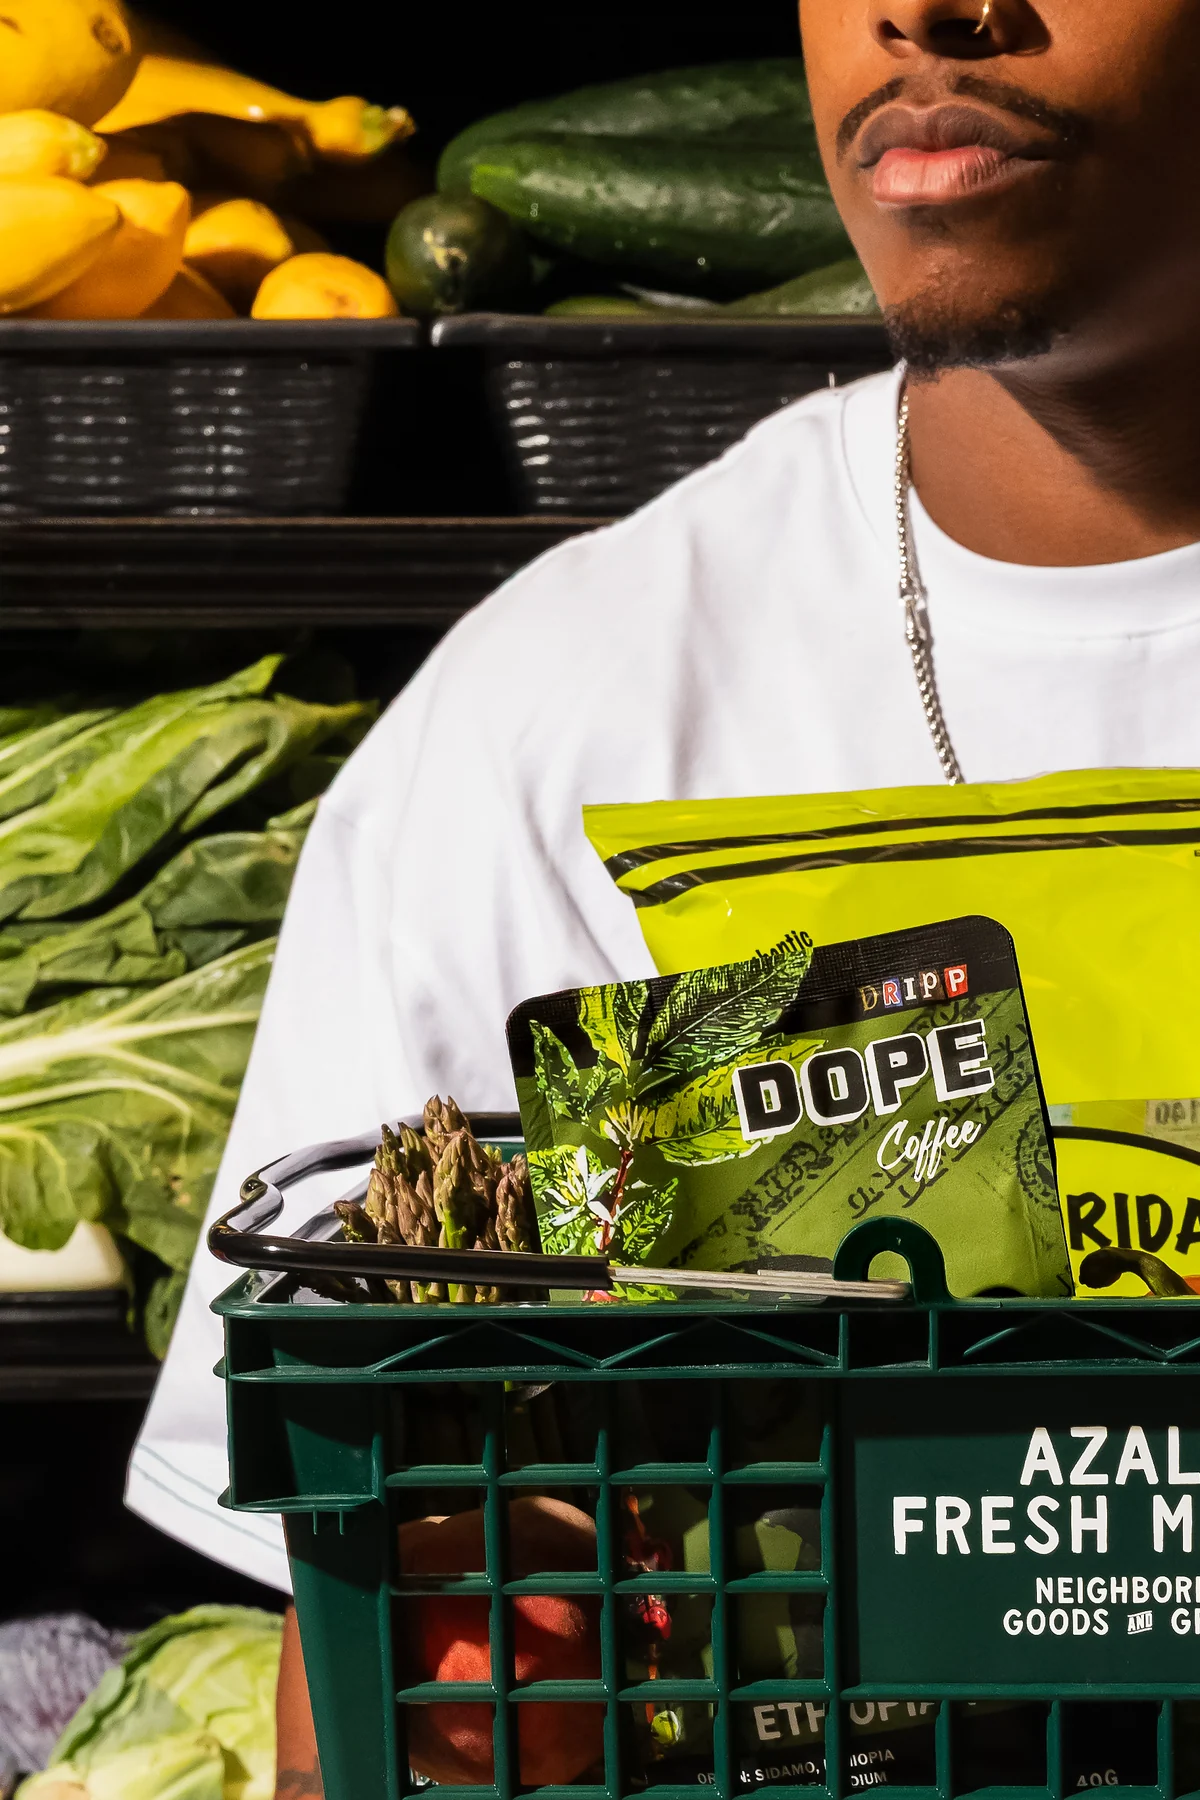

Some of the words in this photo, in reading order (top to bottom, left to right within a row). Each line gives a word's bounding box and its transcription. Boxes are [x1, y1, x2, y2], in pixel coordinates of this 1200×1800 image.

[858, 964, 968, 1012] DRIPP
[731, 1018, 996, 1142] DOPE
[876, 1115, 982, 1183] Coffee
[892, 1495, 1108, 1555] FRESH
[1003, 1607, 1110, 1636] GOODS
[1127, 1611, 1154, 1634] AND
[755, 1761, 820, 1782] SIDAMO,
